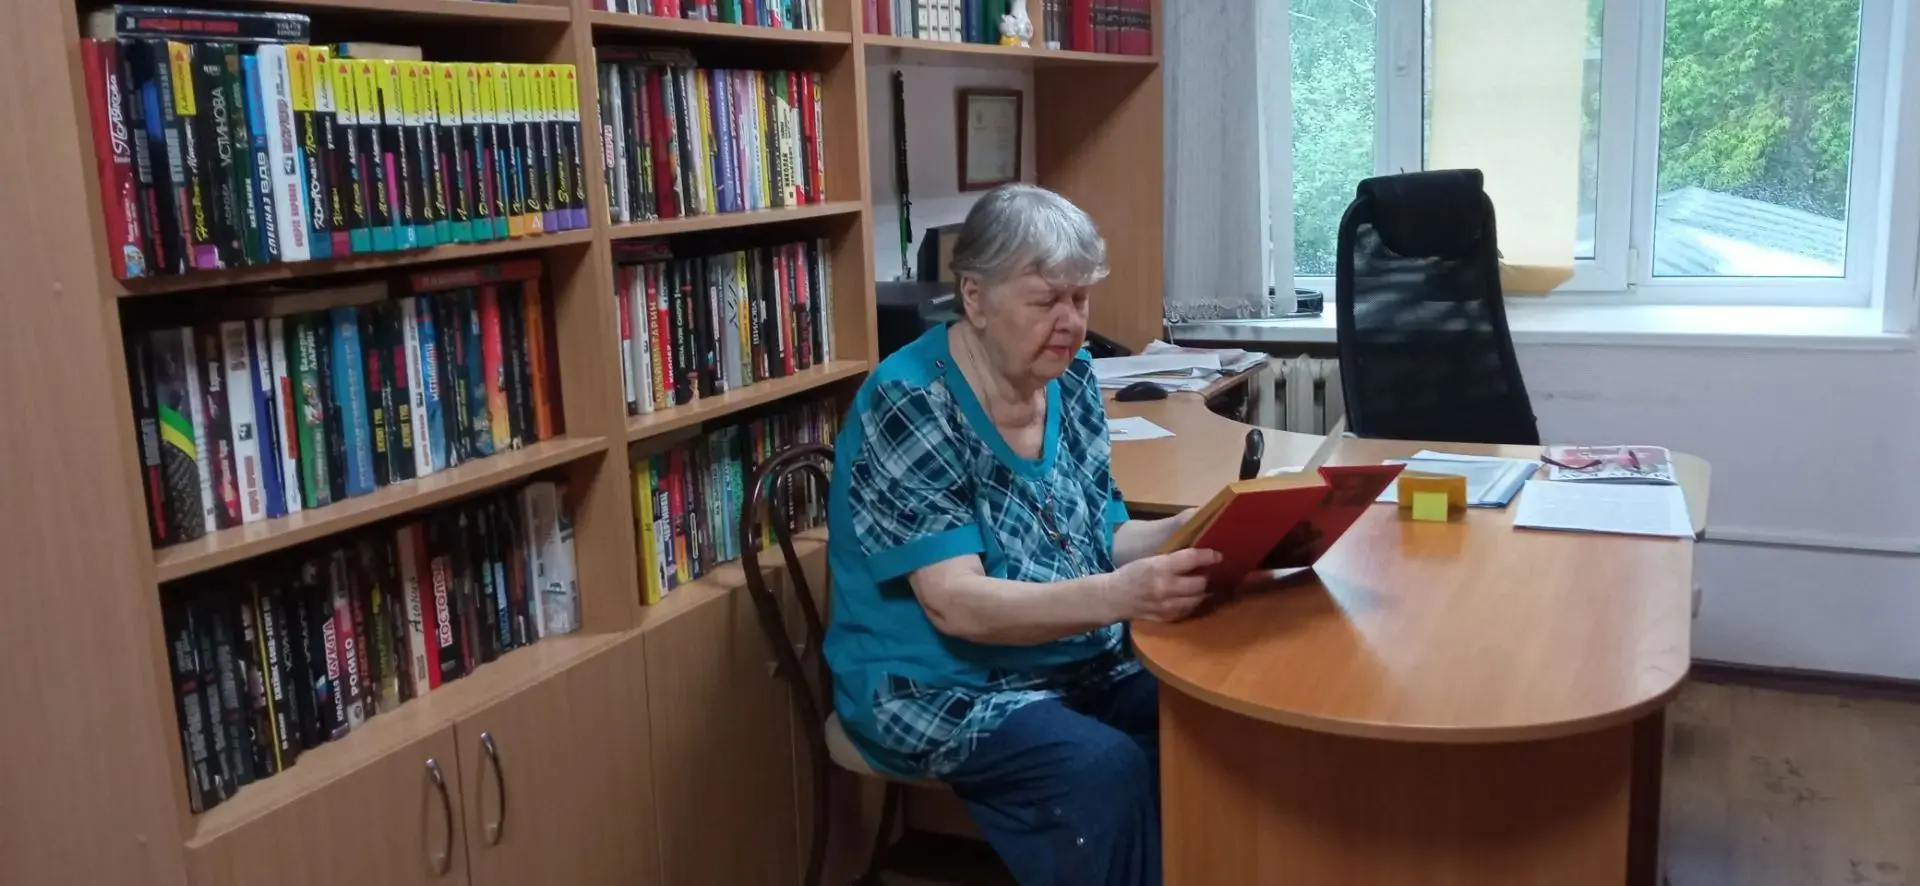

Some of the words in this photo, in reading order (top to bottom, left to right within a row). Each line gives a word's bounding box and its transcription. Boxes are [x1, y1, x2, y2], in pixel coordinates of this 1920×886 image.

[104, 66, 129, 157] Полякова
[212, 86, 231, 166] УСТИНОВА
[257, 152, 269, 194] ВДВ
[263, 196, 277, 255] СПЕЦНАЗ
[650, 301, 659, 343] ГАРИН
[750, 299, 759, 344] ШИЛОВА
[321, 618, 341, 679] КУКЛА
[343, 638, 361, 696] РОМЕО
[331, 679, 345, 721] КРАСНАЯ
